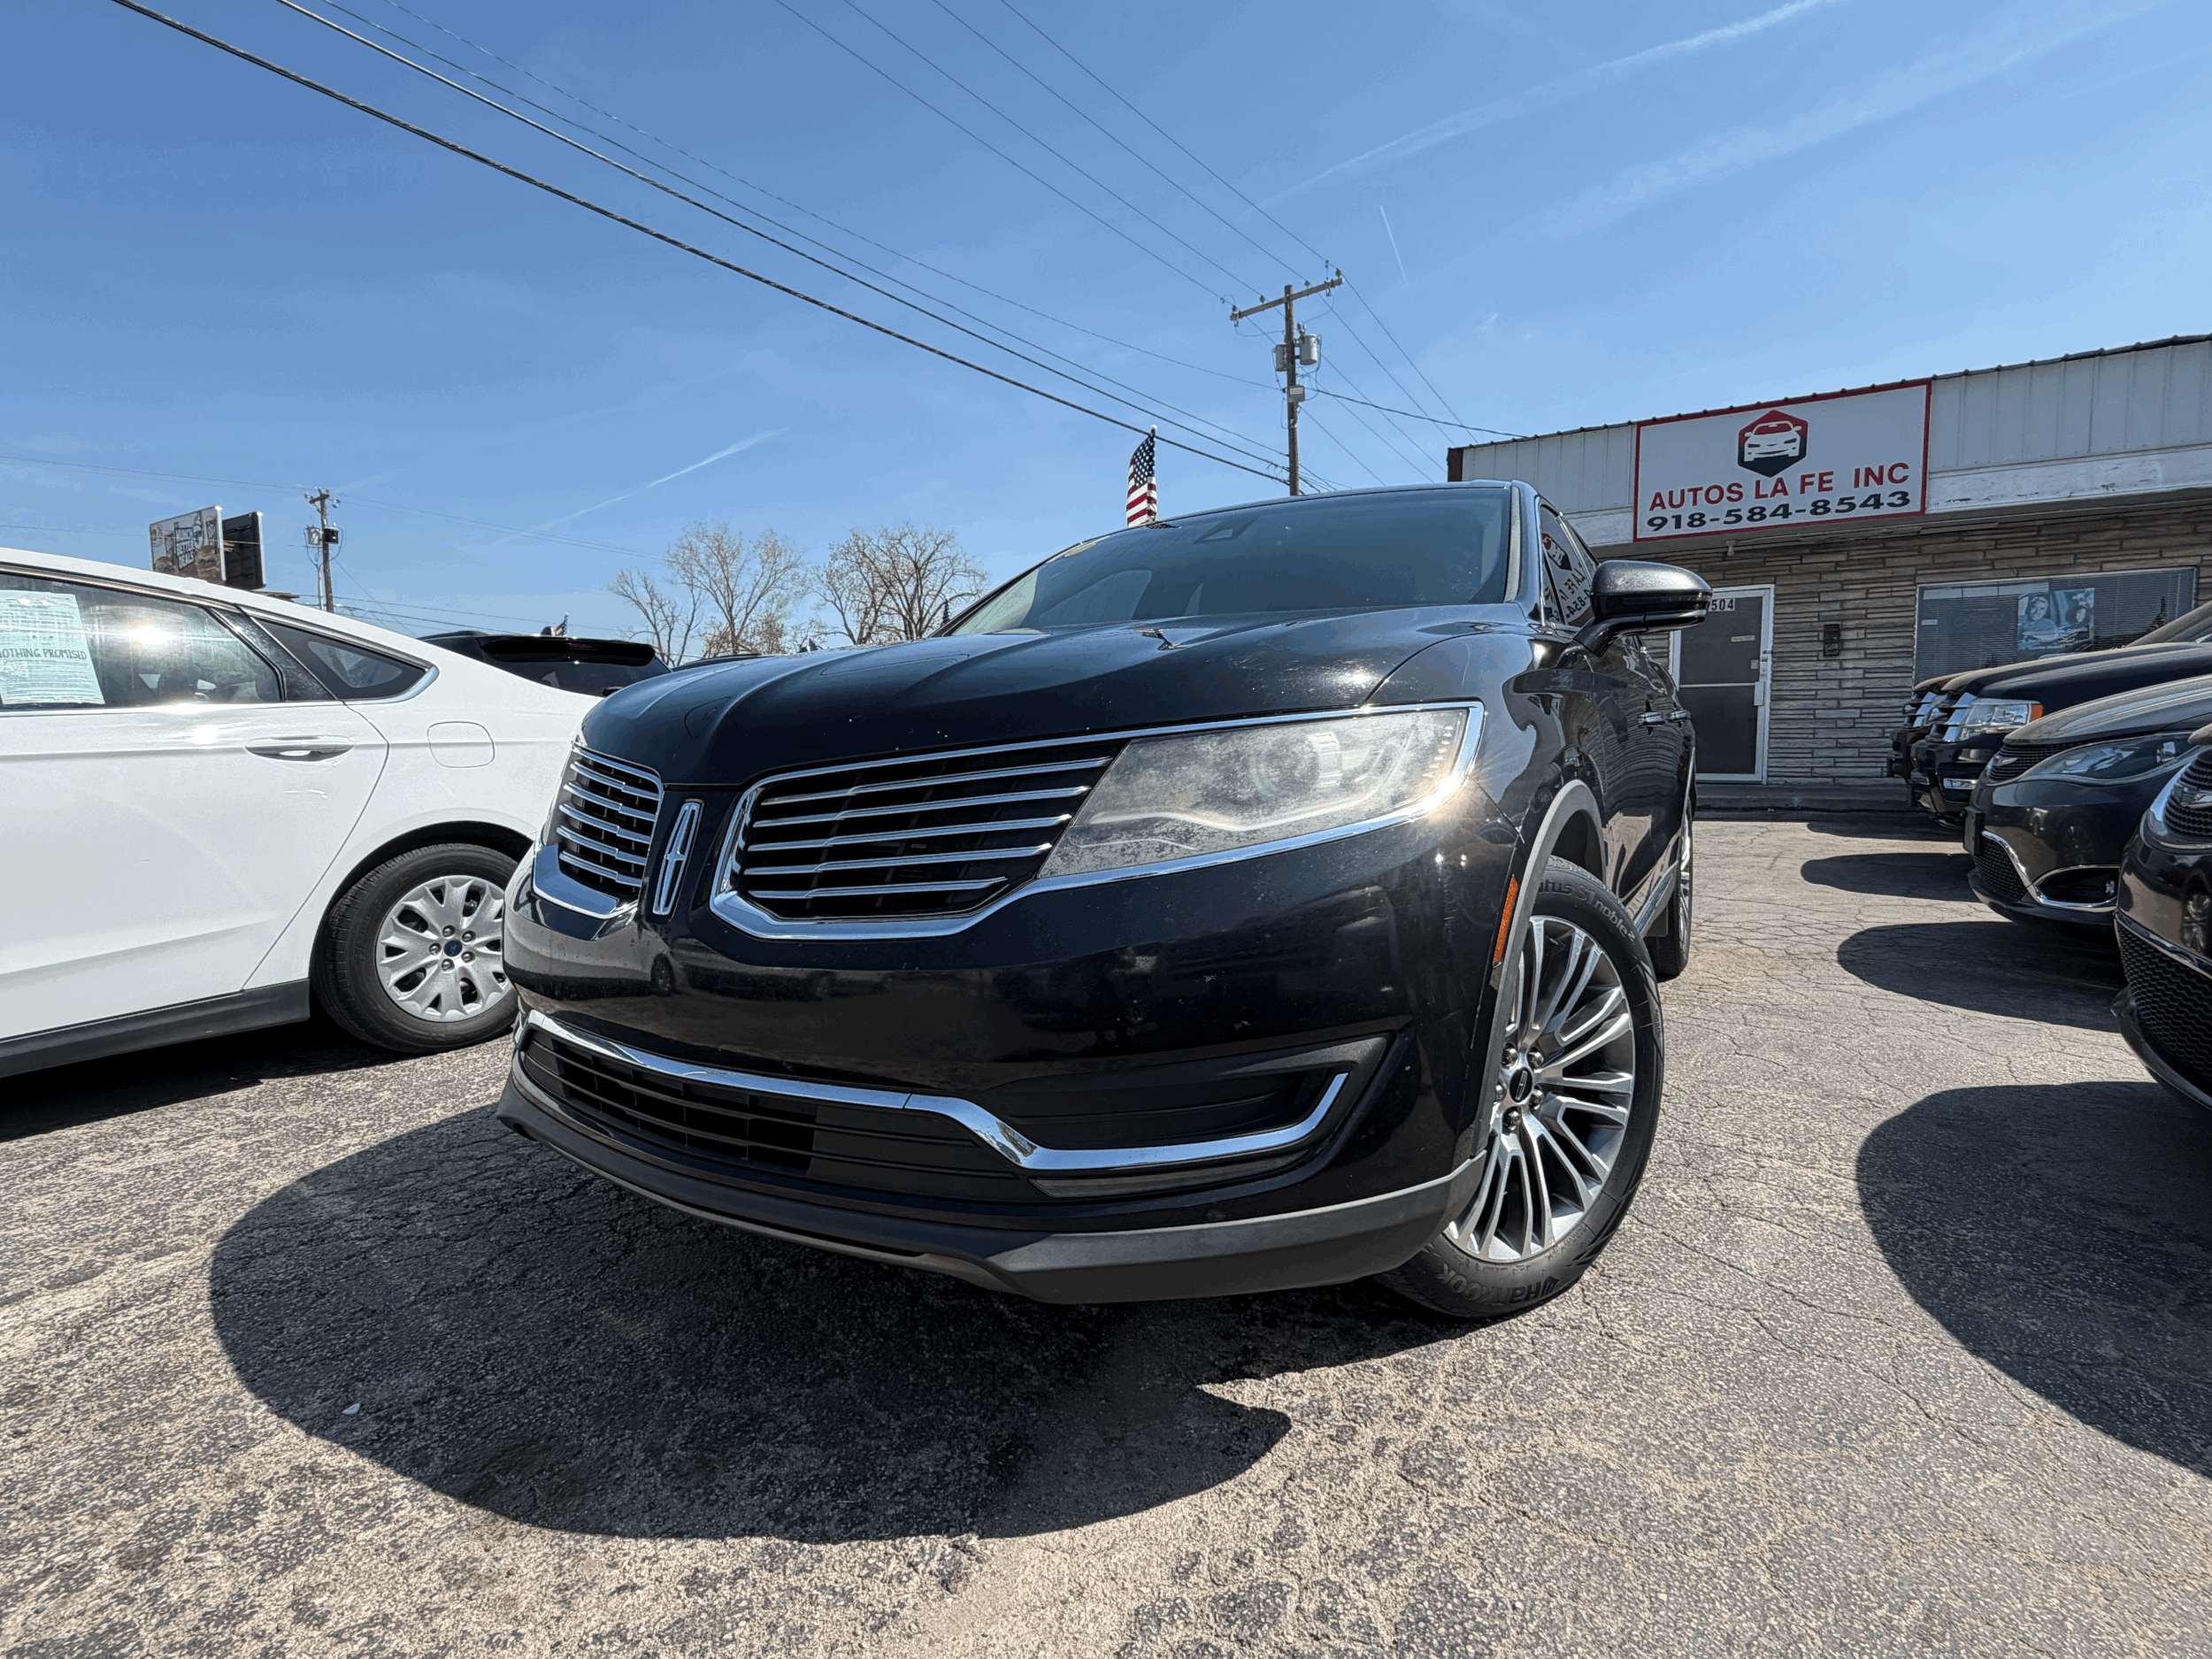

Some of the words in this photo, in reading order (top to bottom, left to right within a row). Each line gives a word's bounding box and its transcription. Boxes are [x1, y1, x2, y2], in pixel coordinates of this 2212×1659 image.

[1648, 482, 1744, 511] AUTOS
[1755, 477, 1788, 500] LA
[1800, 471, 1834, 495] FE
[1854, 462, 1909, 488] INC
[1647, 490, 1910, 532] 918-584-8543
[1710, 599, 1734, 611] 504
[42, 648, 87, 659] PROMISED
